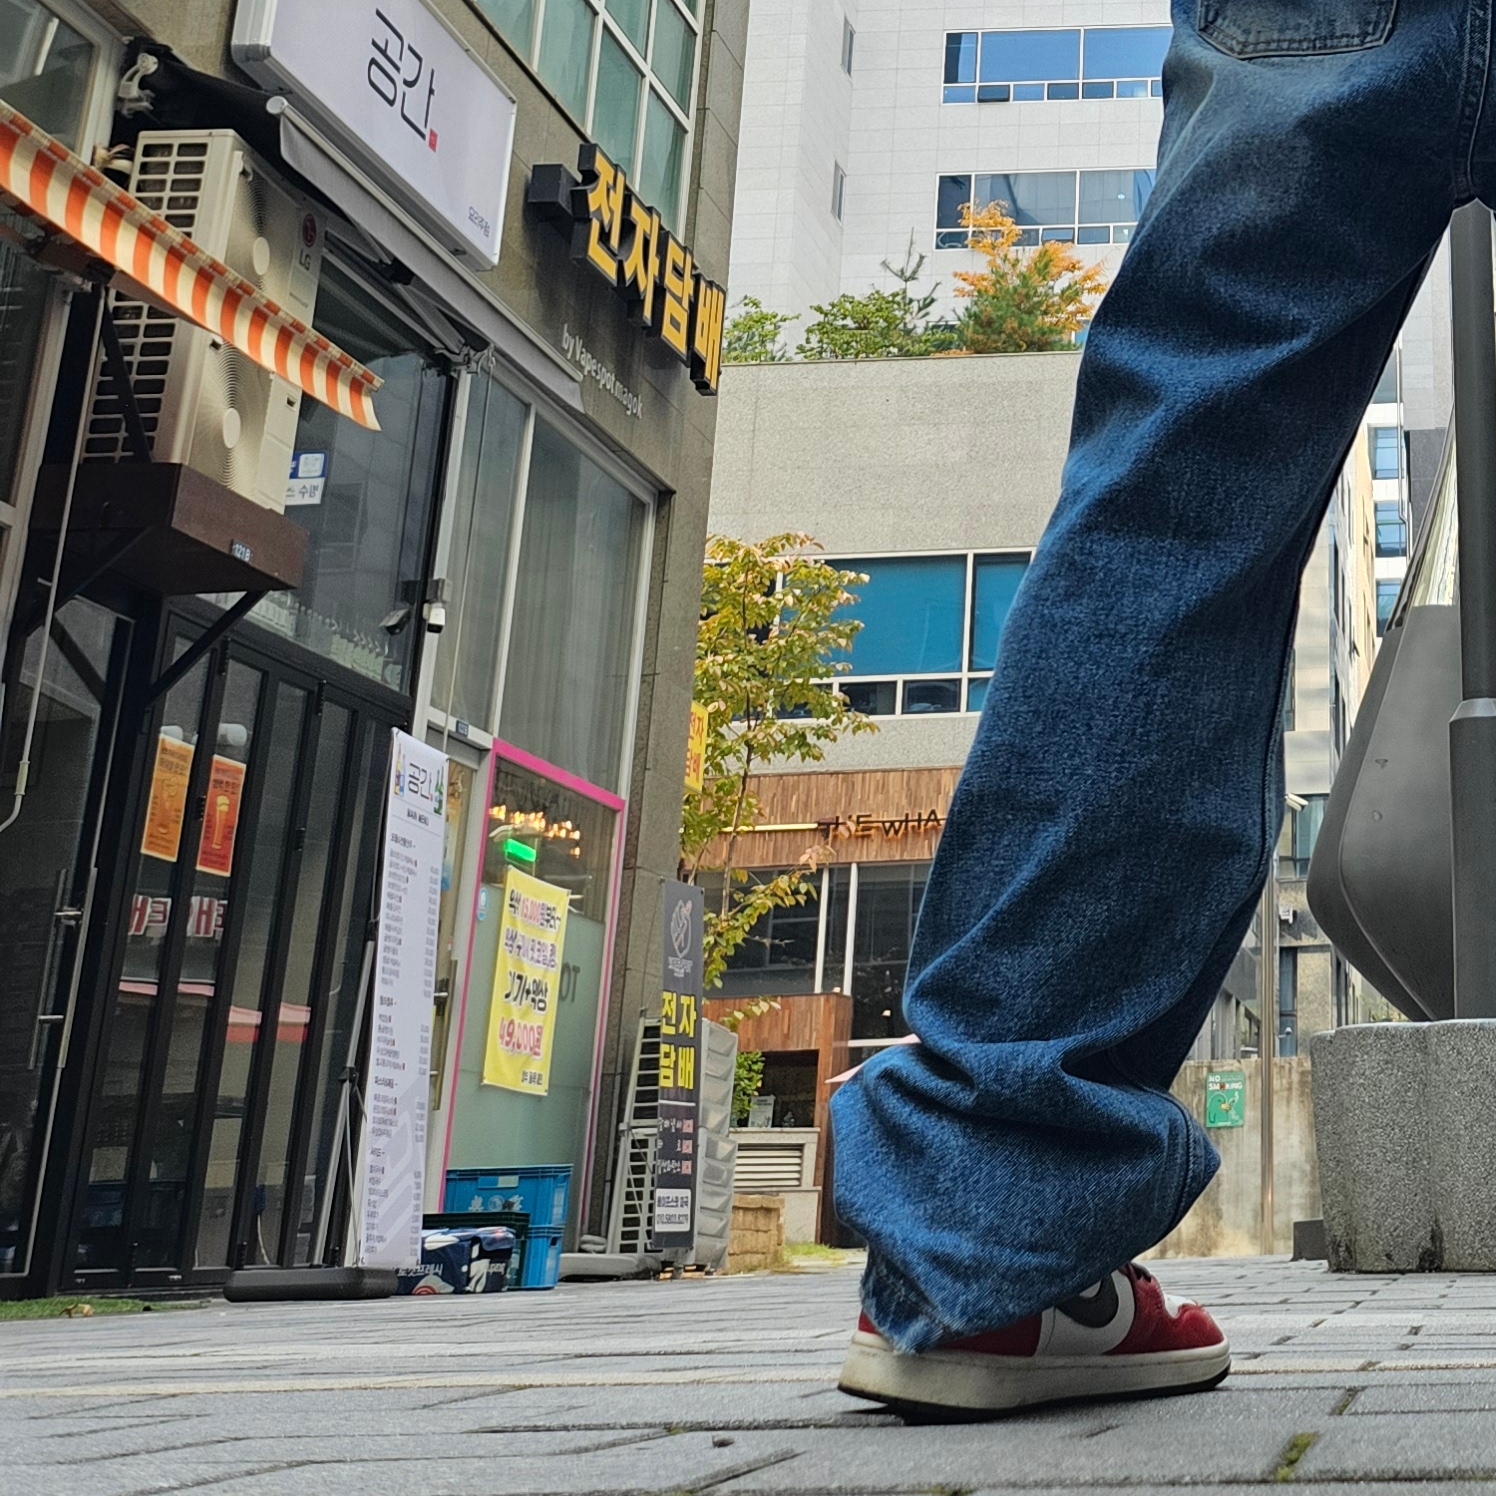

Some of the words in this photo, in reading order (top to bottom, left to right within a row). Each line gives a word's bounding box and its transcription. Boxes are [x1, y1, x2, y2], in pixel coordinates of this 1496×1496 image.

[367, 7, 436, 142] 공간
[468, 206, 491, 239] 요리주점
[299, 248, 311, 272] LG
[586, 146, 727, 393] 전자담배
[562, 323, 575, 360] by
[615, 377, 643, 419] magok
[407, 762, 433, 800] 공간
[662, 990, 697, 1038] 전자
[498, 1016, 544, 1057] 49,000원
[659, 1043, 695, 1090] 담배
[1208, 1075, 1221, 1083] NO
